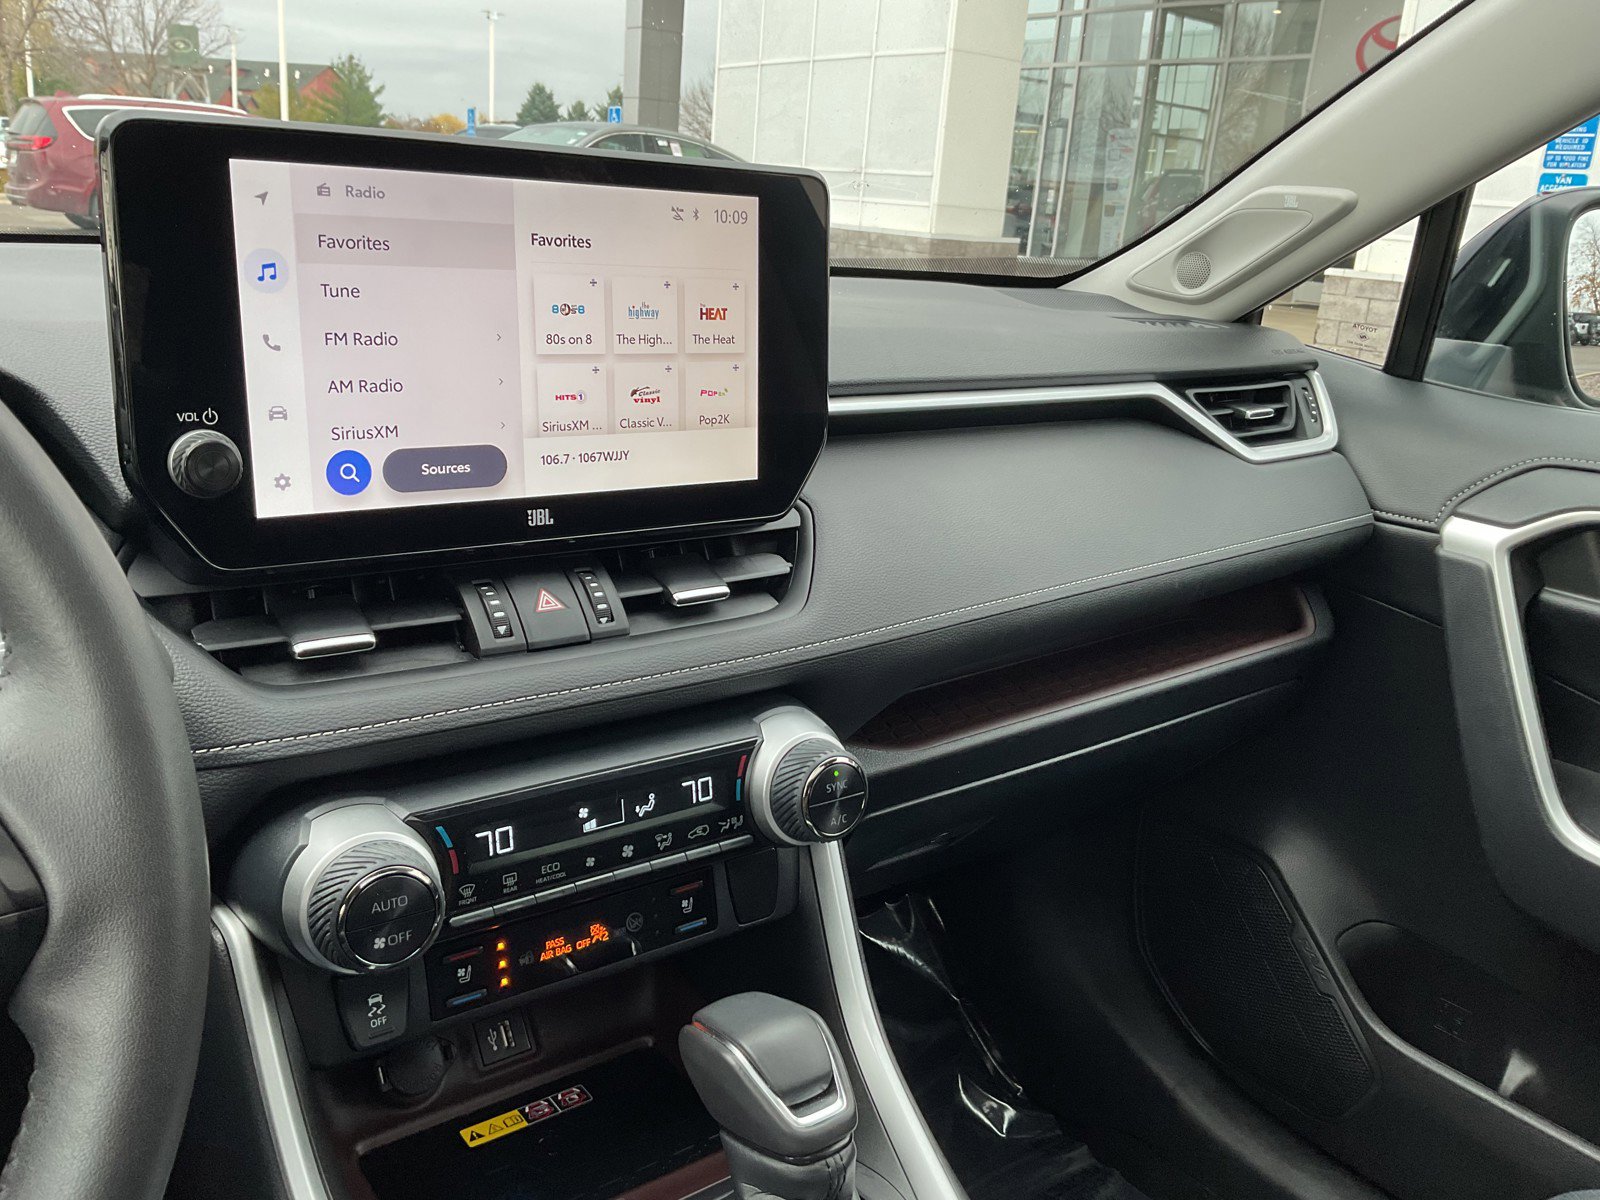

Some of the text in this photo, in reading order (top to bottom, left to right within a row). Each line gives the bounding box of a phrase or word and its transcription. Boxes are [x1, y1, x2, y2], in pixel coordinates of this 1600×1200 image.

[1555, 176, 1572, 184] VAN
[345, 185, 386, 199] Radio
[713, 209, 748, 224] 10:09
[317, 234, 390, 251] Favorites
[530, 233, 592, 249] Favorites
[320, 283, 361, 299] Tune
[628, 306, 659, 319] highway
[699, 307, 728, 321] HEAT
[324, 332, 399, 346] FM Radio
[546, 333, 593, 345] 80s on 8
[616, 333, 673, 347] The High...
[692, 334, 736, 345] The Heat
[327, 379, 403, 394] AM Radio
[633, 396, 661, 405] vinyl
[176, 412, 200, 422] VOL
[619, 417, 655, 429] Classic
[699, 414, 730, 427] Pop2K
[331, 425, 399, 441] SiriusXM
[542, 419, 589, 433] SiriusXM
[540, 453, 570, 466] 106.7
[578, 450, 630, 464] 1067WJJY
[421, 463, 471, 475] Sources
[527, 508, 554, 527] JBL
[682, 776, 713, 804] 70
[826, 780, 848, 794] SYNC
[831, 813, 848, 826] A/C
[475, 825, 514, 857] 70
[541, 862, 561, 875] ECO
[535, 872, 567, 885] HEAT/COOL
[503, 886, 518, 895] REAR
[371, 895, 409, 914] AUTO
[458, 896, 477, 907] FRONT
[387, 929, 413, 947] OFF
[545, 936, 565, 950] PASS
[540, 937, 591, 962] AIR BAG OFF
[370, 1016, 387, 1028] OFF
